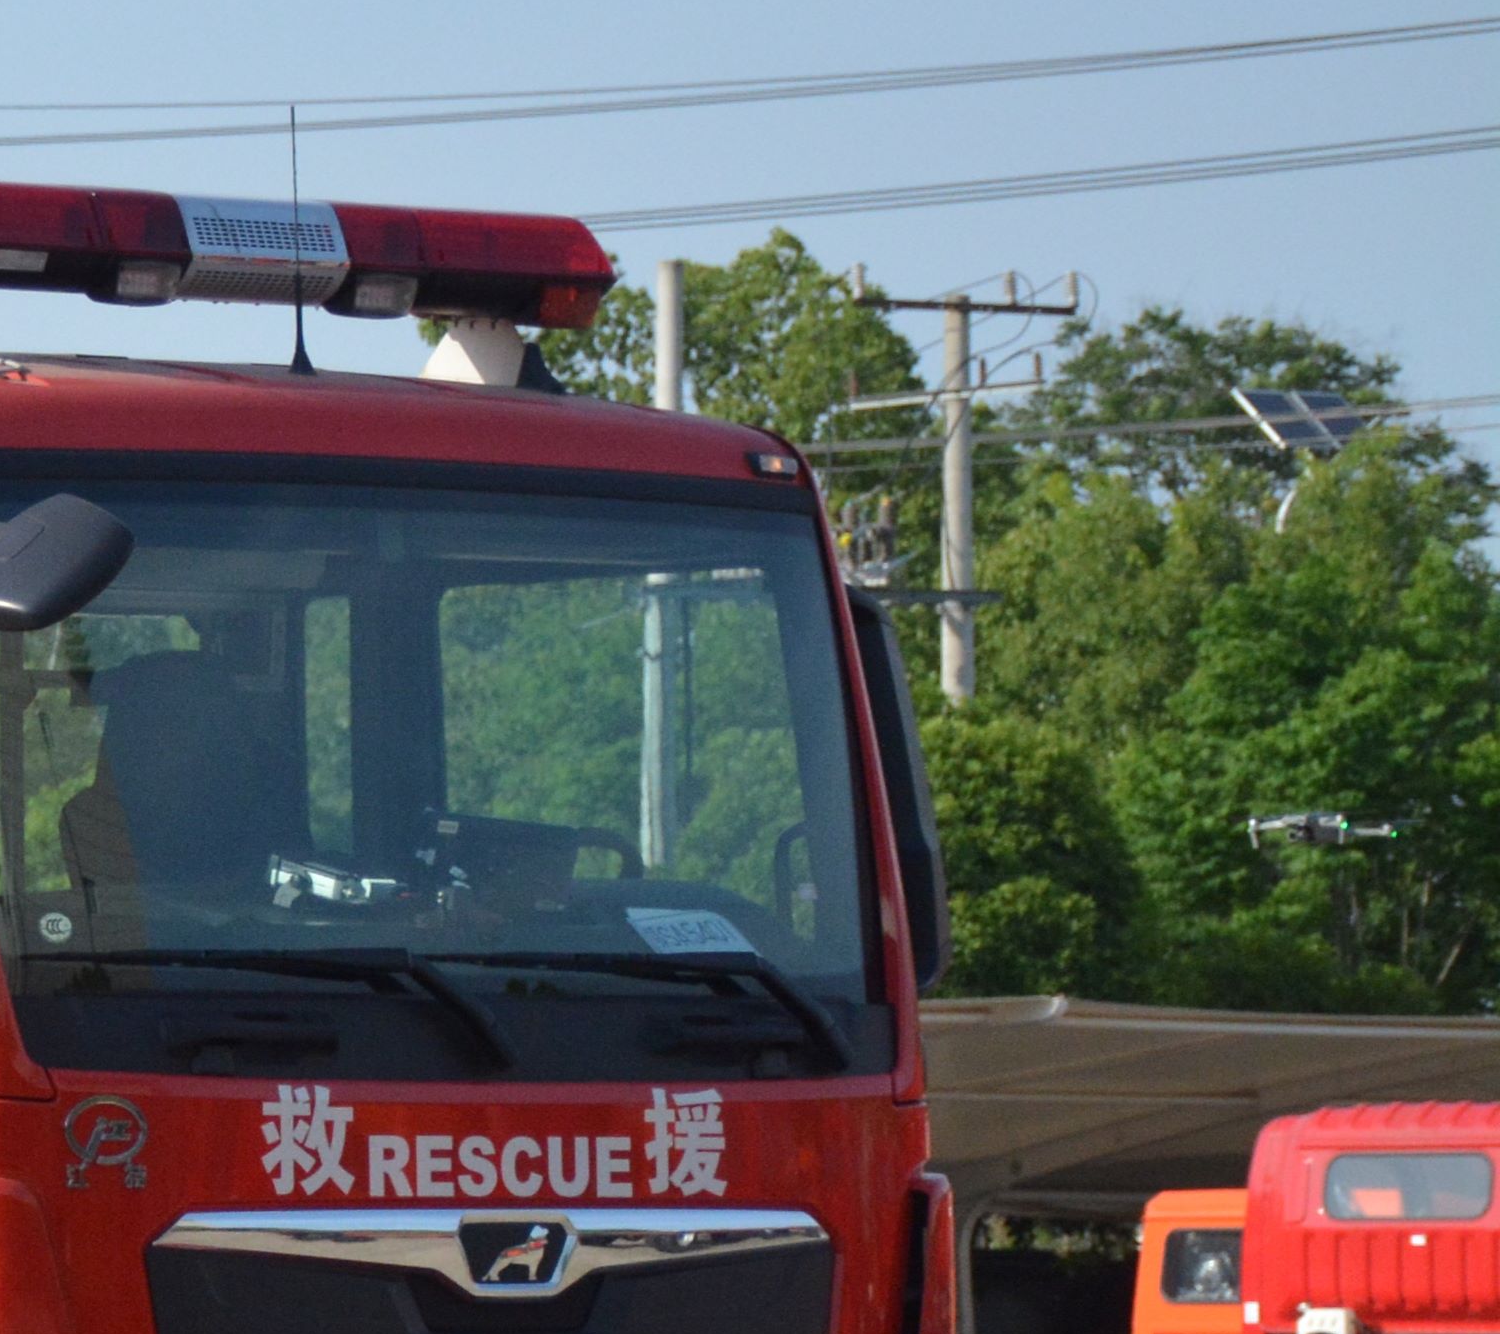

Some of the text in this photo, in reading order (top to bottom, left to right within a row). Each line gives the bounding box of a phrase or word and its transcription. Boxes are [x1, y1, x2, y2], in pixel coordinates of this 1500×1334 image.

[262, 1085, 727, 1198] 救 RESCUE 援
